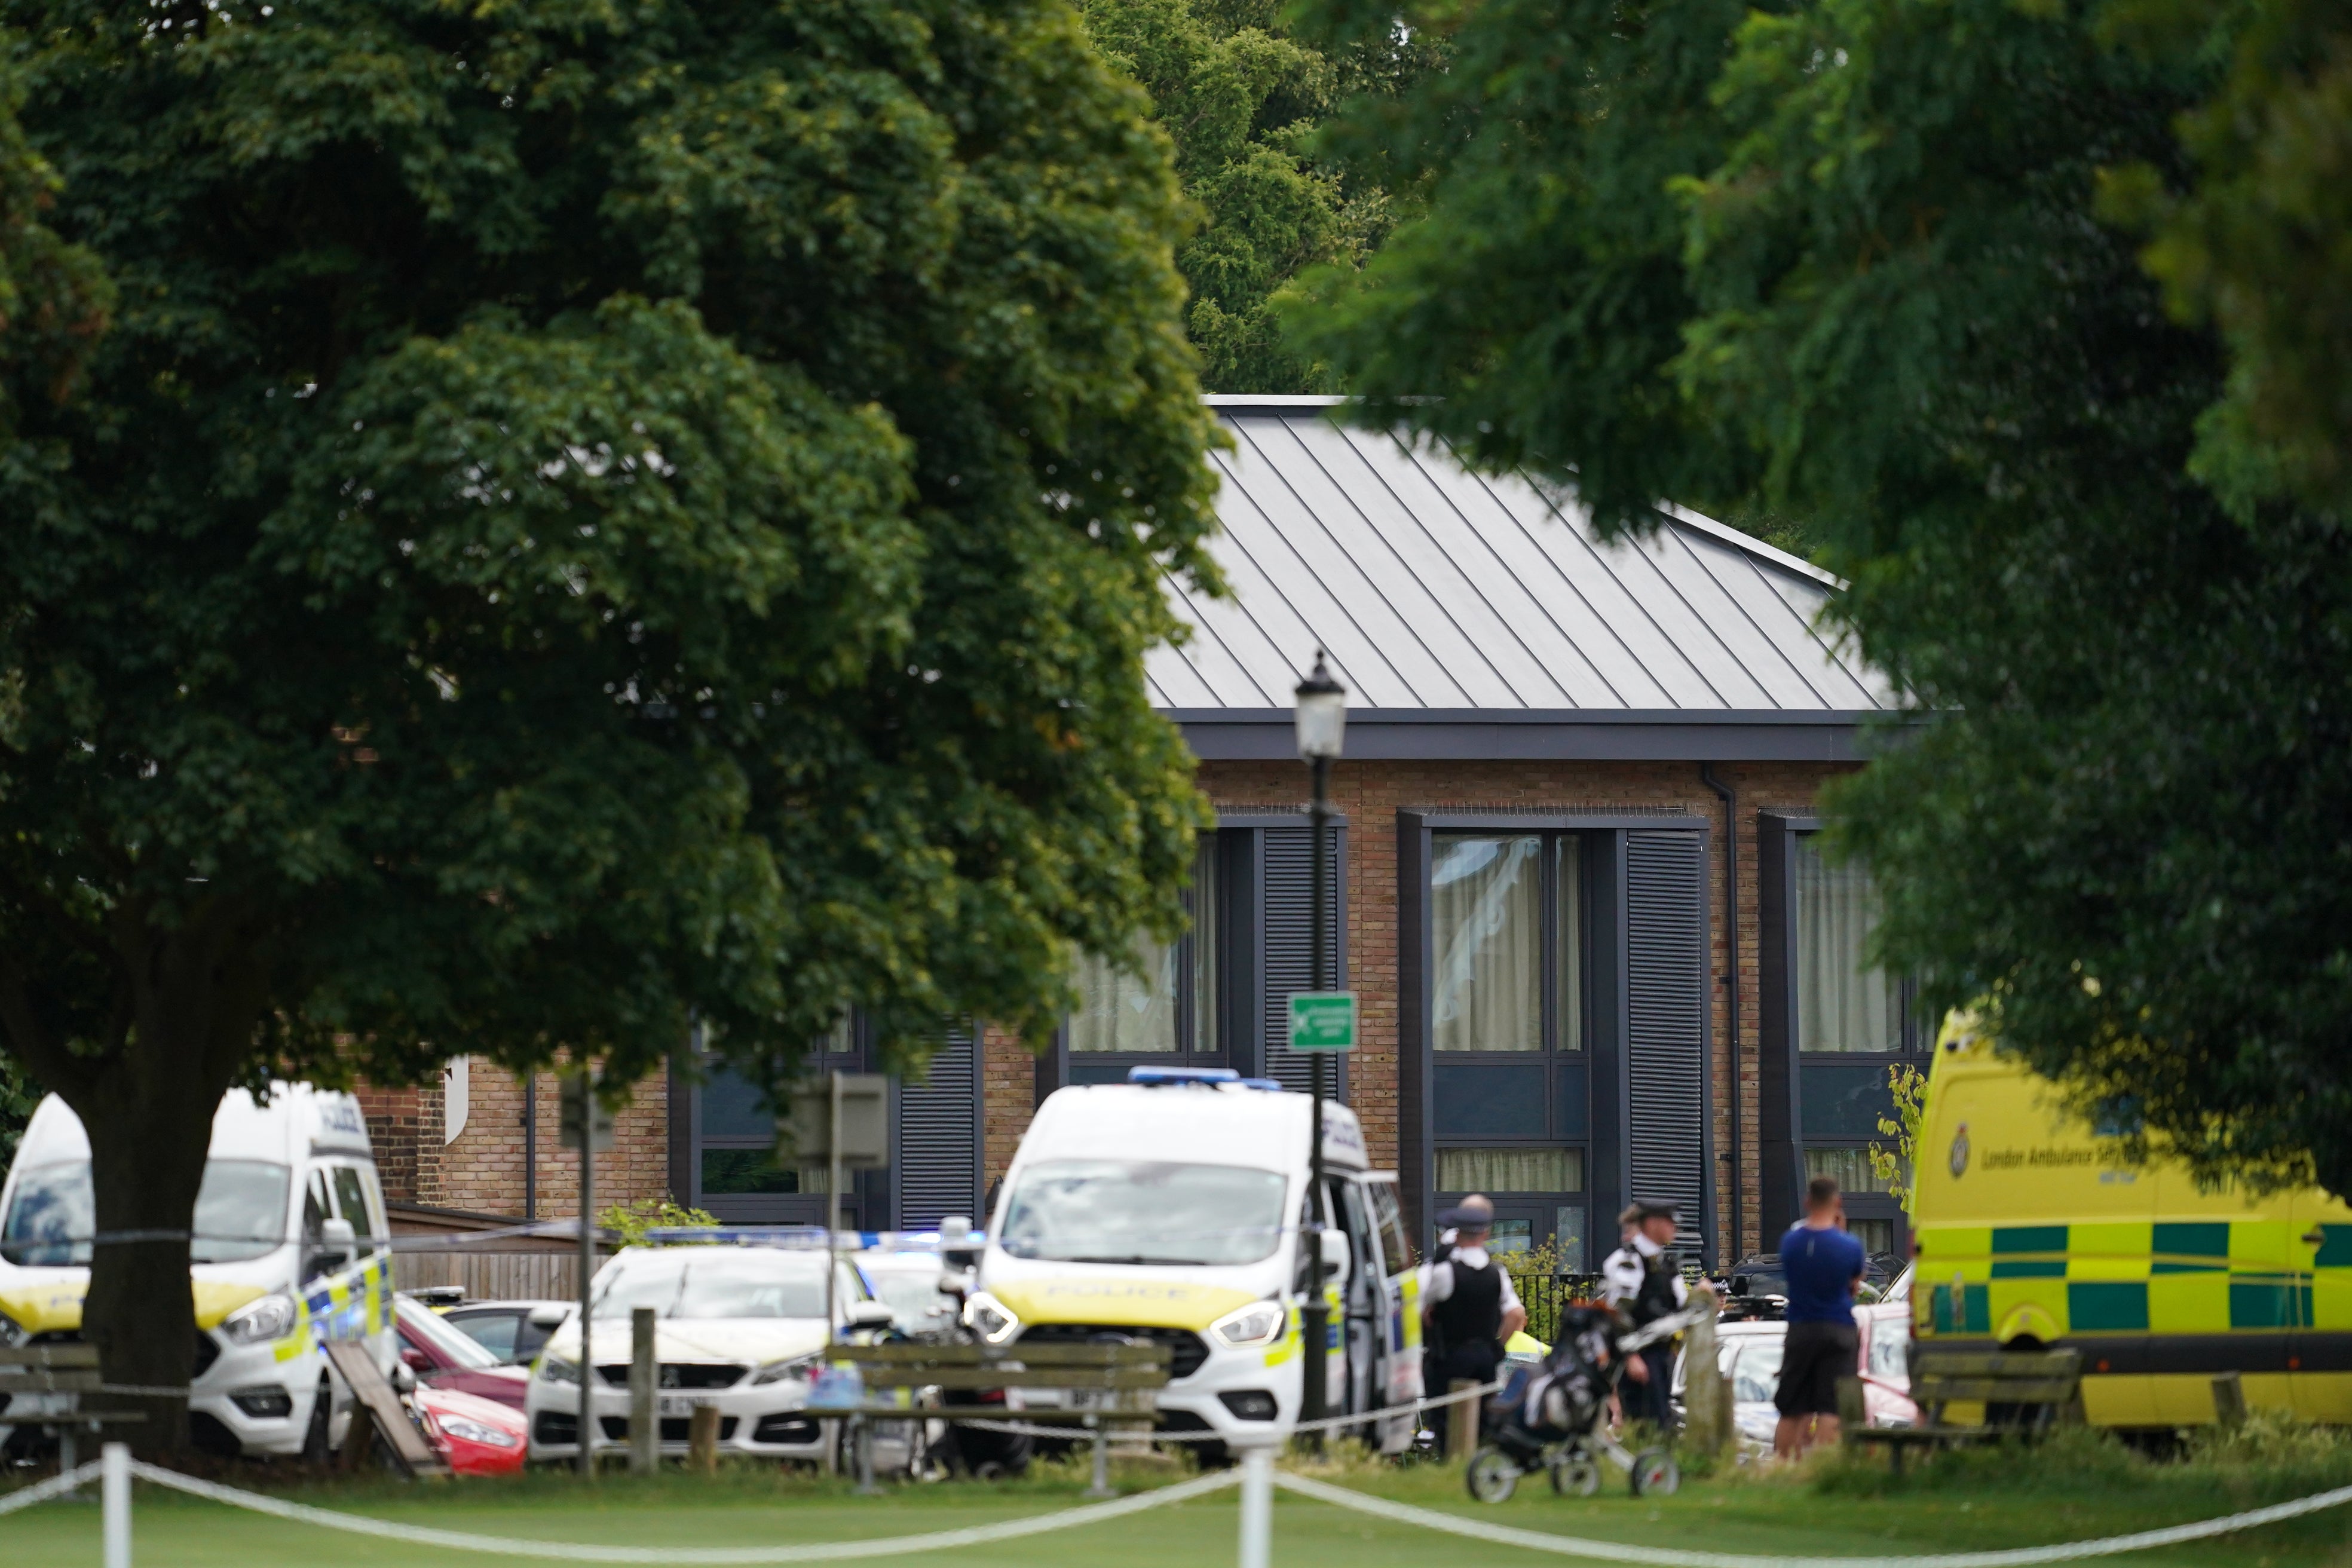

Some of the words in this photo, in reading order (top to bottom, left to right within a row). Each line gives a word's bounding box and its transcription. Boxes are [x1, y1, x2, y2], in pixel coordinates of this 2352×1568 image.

[1980, 1145, 2026, 1171] London
[2028, 1142, 2092, 1167] Ambulance
[1046, 1284, 1190, 1302] POLICE
